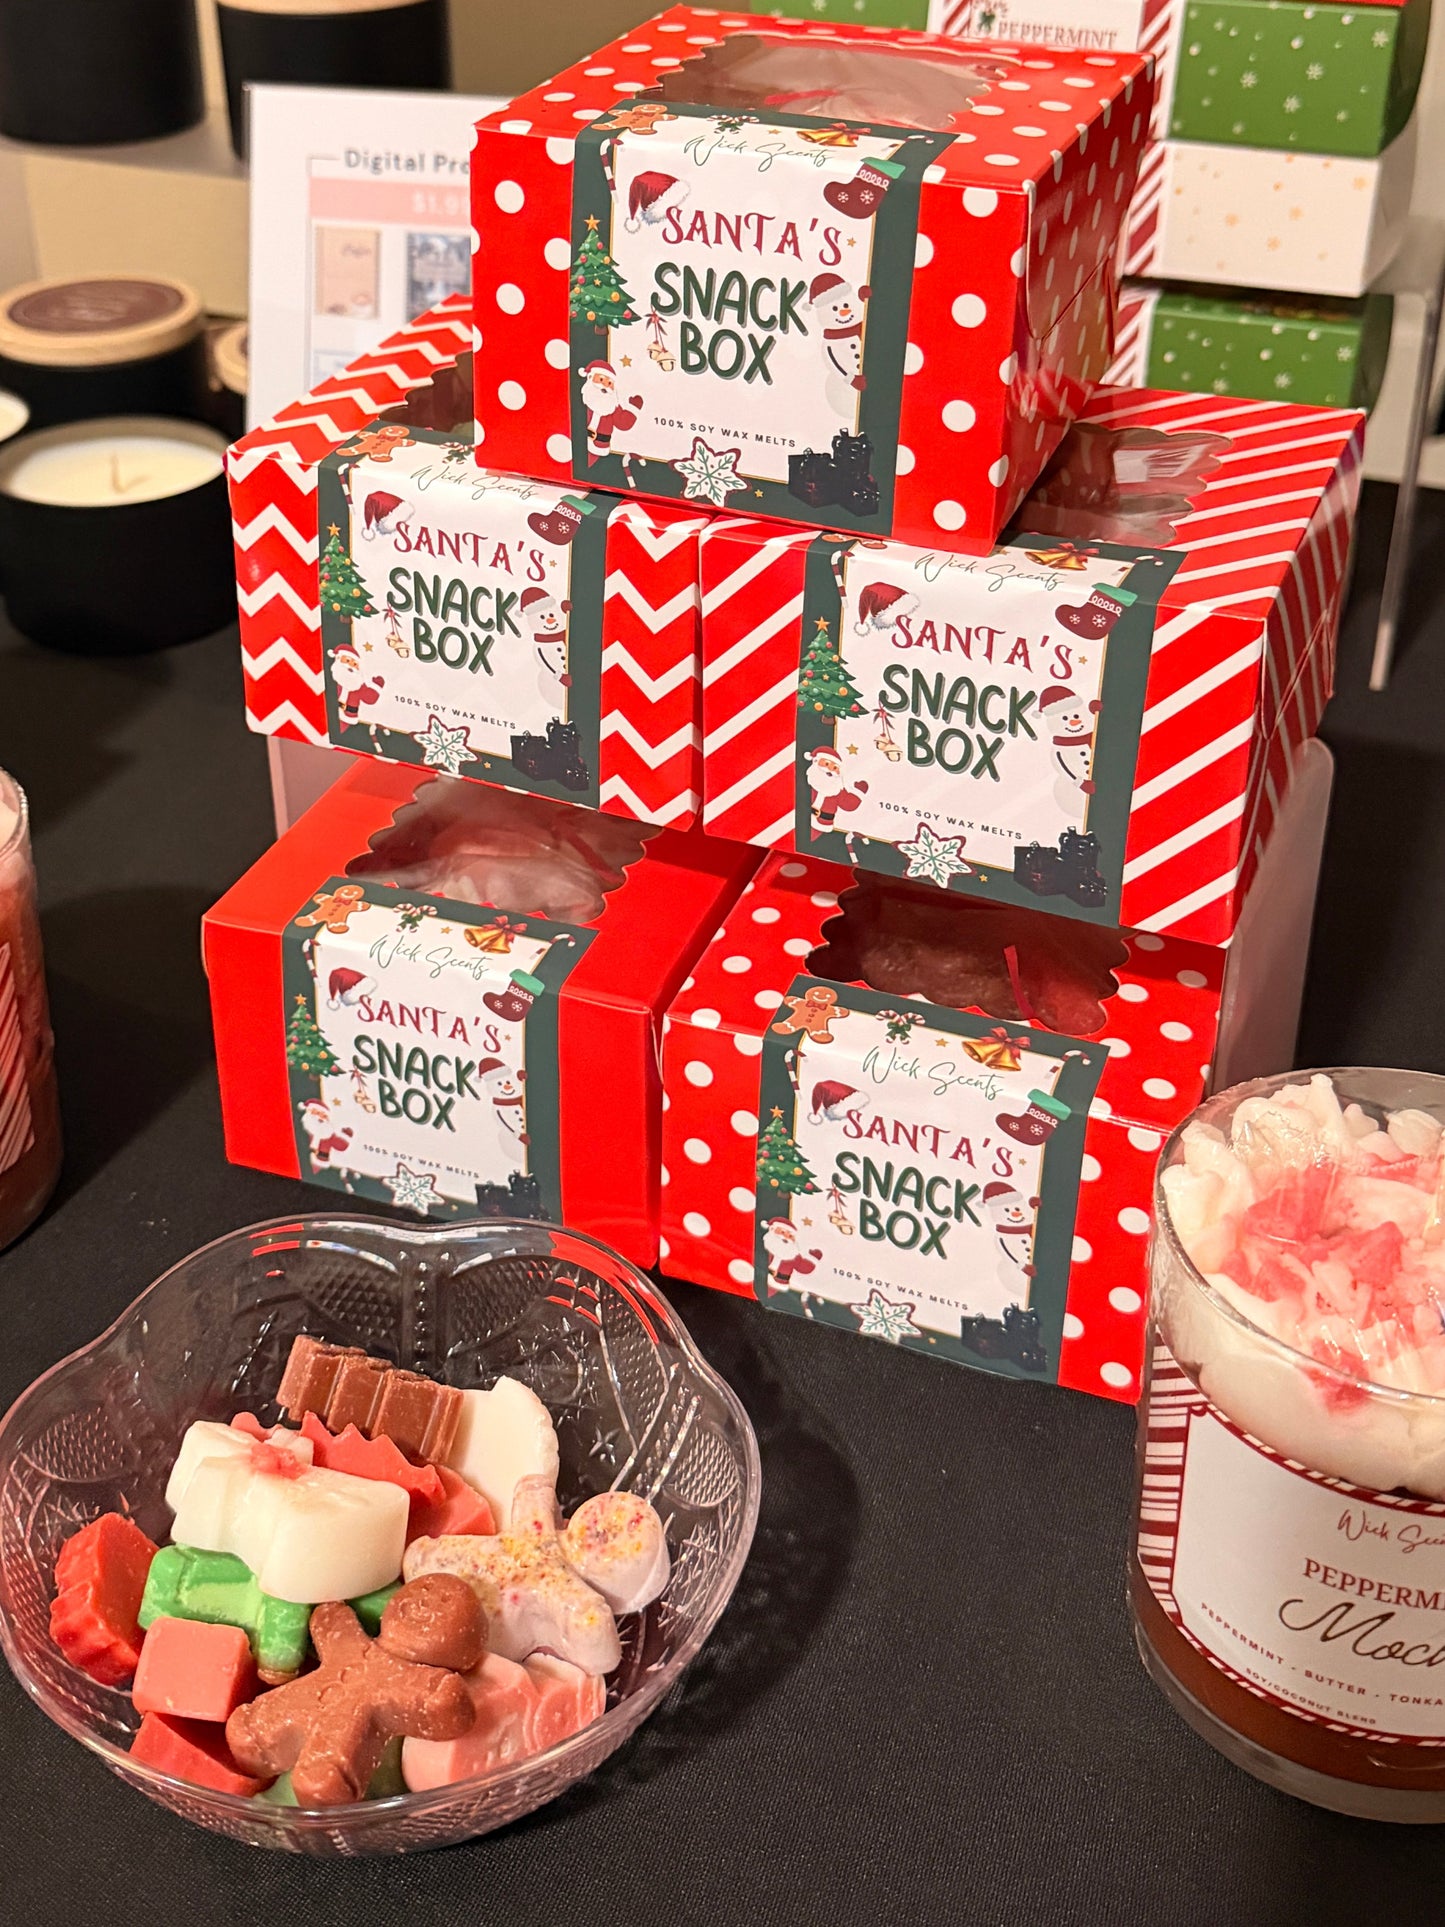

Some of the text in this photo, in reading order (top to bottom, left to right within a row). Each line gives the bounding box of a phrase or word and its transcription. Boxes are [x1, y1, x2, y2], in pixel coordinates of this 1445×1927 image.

[999, 21, 1118, 50] PEPPERMINT
[343, 149, 425, 175] Digital
[684, 135, 837, 172] Wick Scents
[662, 206, 842, 266] SANTA'S
[651, 262, 809, 336] SNACK
[680, 321, 776, 385] BOX
[654, 417, 796, 448] 100% SOY WAX MELTS
[410, 465, 543, 501] Wick Scents
[394, 521, 545, 582] SANTA'S
[914, 552, 1068, 592] Wick Scents
[387, 567, 522, 638] SNACK
[413, 617, 495, 676] BOX
[891, 614, 1074, 680] SANTA'S
[395, 695, 516, 729] 100% SOY WAX MELTS
[879, 664, 1038, 741] SNACK
[907, 718, 1005, 781] BOX
[879, 801, 1022, 840] 100% SOY WAX MELTS
[369, 934, 493, 980] Wick Scents
[357, 994, 501, 1053] SANTA'S
[352, 1034, 480, 1100] SNACK
[862, 1045, 1004, 1101] Wick Scents
[377, 1079, 456, 1133] BOX
[843, 1109, 1014, 1178] SANTA'S
[831, 1151, 982, 1227] SNACK
[859, 1199, 951, 1259] BOX
[833, 1267, 969, 1310] 100% SOY WAX MELTS
[1337, 1508, 1390, 1541] Wick
[1302, 1557, 1445, 1610] PEPPERM
[1201, 1602, 1443, 1706] PEPPERMINT BUTTER TONKA
[1245, 1667, 1332, 1712] SOY/COCONUT
